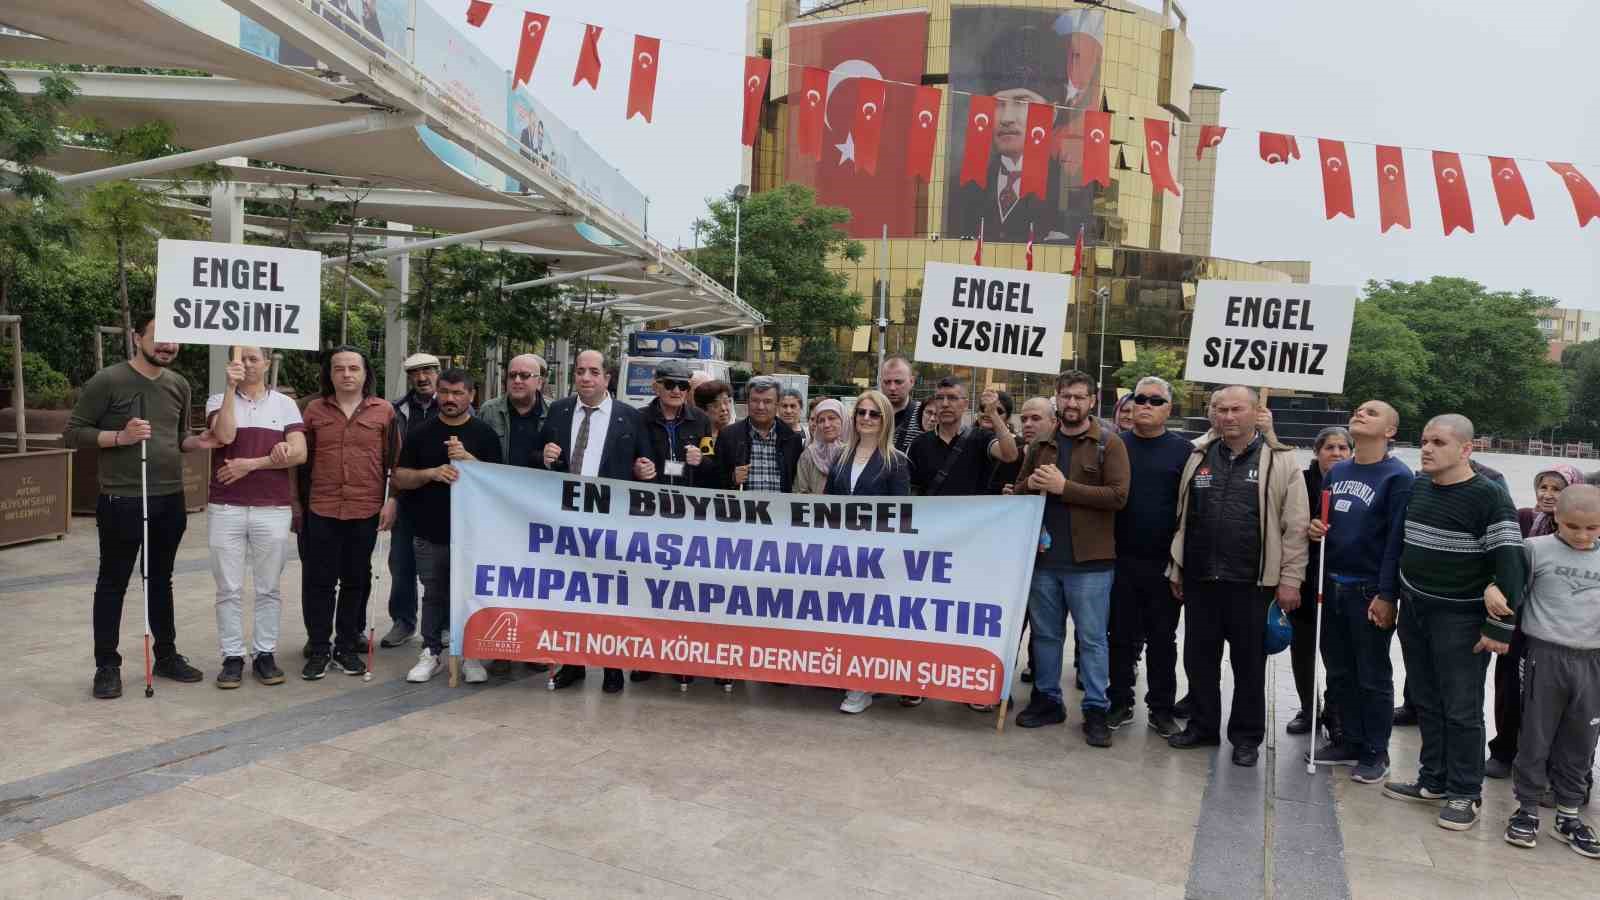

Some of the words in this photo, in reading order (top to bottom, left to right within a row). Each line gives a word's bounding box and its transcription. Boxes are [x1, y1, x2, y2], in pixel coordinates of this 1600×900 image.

[193, 256, 285, 291] ENGEL
[952, 277, 1034, 314] ENGEL
[1225, 295, 1314, 330] ENGEL
[561, 479, 612, 514] EN
[628, 487, 773, 526] BÜYÜK
[790, 501, 919, 534] ENGEL
[528, 522, 886, 580] PAYLAŞAMAMAK
[903, 549, 953, 583] VE
[475, 564, 630, 606] EMPATİ
[645, 577, 1003, 638] YAPAMAMAKTIR
[536, 629, 581, 653] ALTI
[586, 632, 655, 659] NOKTA
[660, 636, 745, 667] KÖRLER
[749, 646, 842, 676] DERNEĞİ
[846, 655, 913, 682] AYDIN
[917, 662, 996, 690] ŞUBESİ
